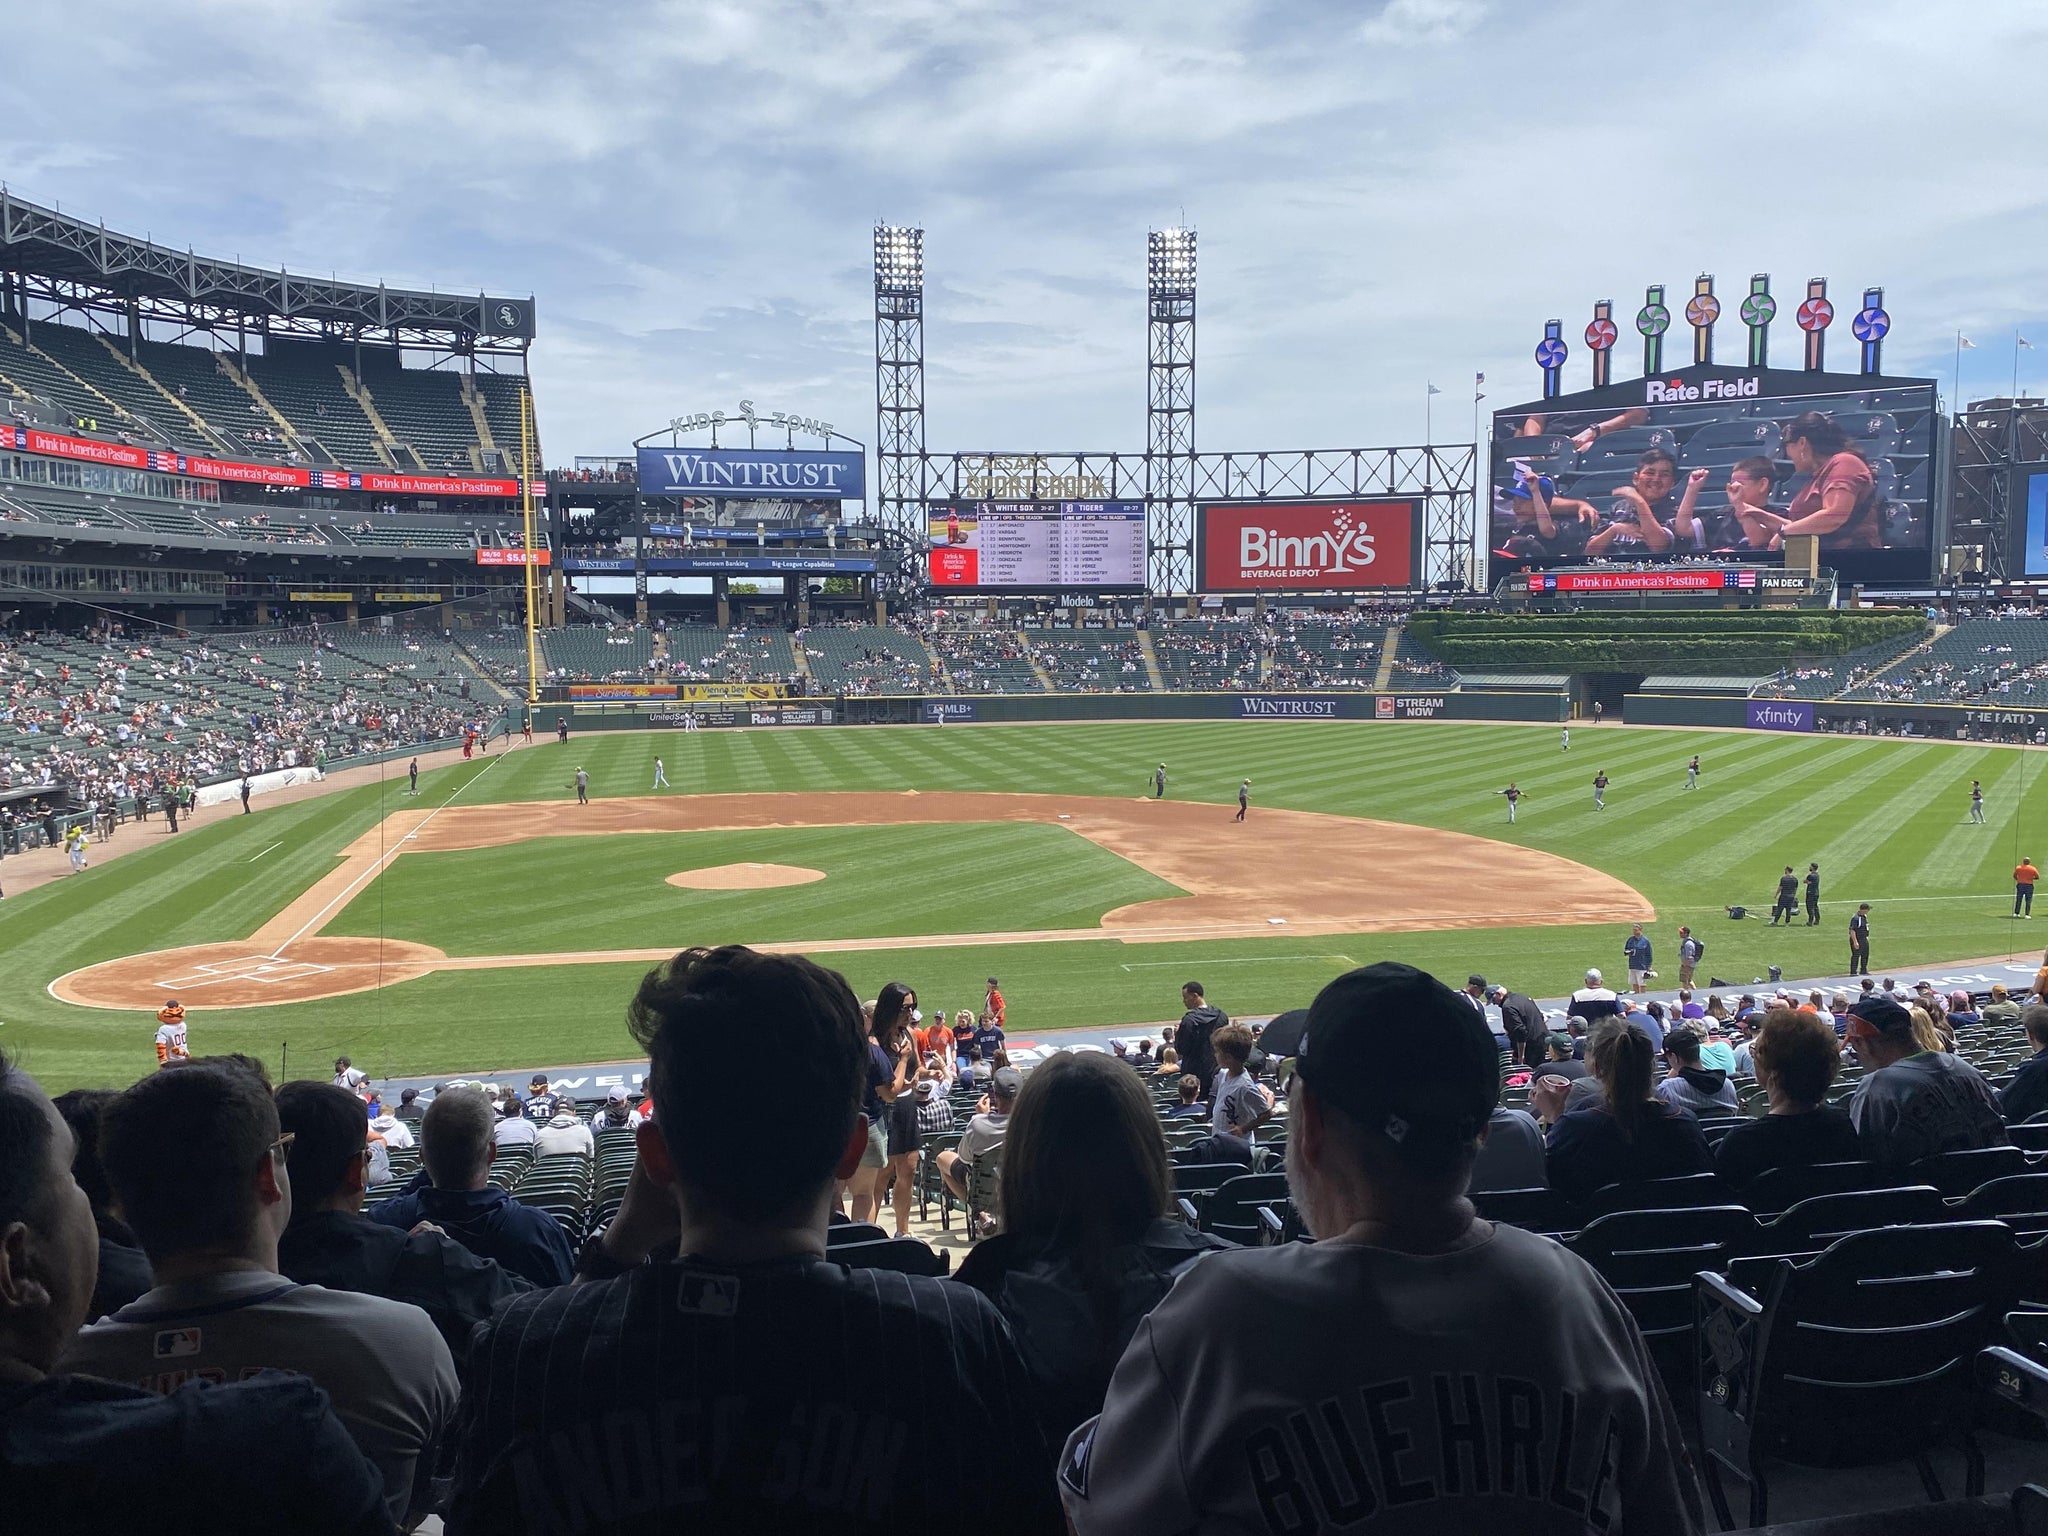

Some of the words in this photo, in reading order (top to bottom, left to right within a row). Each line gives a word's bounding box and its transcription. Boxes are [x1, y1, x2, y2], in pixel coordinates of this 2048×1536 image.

[1646, 380, 1699, 403] Rate
[1703, 377, 1759, 399] Field
[669, 410, 727, 435] KIDS
[771, 411, 834, 440] ZONE
[36, 436, 59, 451] Drink
[60, 438, 68, 452] in
[68, 441, 107, 459] America's
[107, 448, 137, 464] Pastime
[966, 455, 1049, 471] CAESARS
[194, 462, 211, 473] Drink
[212, 463, 221, 475] in
[222, 465, 262, 480] America's
[262, 470, 296, 483] Pastime
[663, 454, 842, 487] WINTRUST
[372, 477, 400, 489] Drink
[402, 478, 411, 489] in
[413, 479, 460, 492] America's
[462, 481, 503, 493] Pastime
[966, 475, 1106, 498] SPORTSBOOK
[1240, 521, 1376, 573] Binny's
[578, 560, 621, 569] WINTRUST
[692, 560, 724, 568] Hometown
[725, 560, 749, 569] Banking
[771, 560, 803, 569] Big-League
[803, 561, 836, 569] Capabilities
[1240, 569, 1288, 578] BEVERAGE
[1289, 569, 1320, 577] DEPOT
[1572, 577, 1600, 588] Drink
[1602, 576, 1612, 588] in
[1614, 575, 1664, 588] America's
[1666, 575, 1709, 587] Pastime
[1762, 578, 1781, 588] FAN
[1782, 578, 1804, 588] DECK
[1061, 595, 1094, 607] Modelo
[595, 687, 632, 698] Surfside
[701, 686, 728, 694] Vienna
[731, 685, 749, 694] Beef
[945, 704, 973, 714] MLB+
[1242, 697, 1336, 714] WINTRUST
[1396, 699, 1444, 708] STREAM
[751, 713, 776, 725] Rate
[1406, 708, 1434, 717] NOW
[1755, 707, 1803, 727] xfinity
[174, 1032, 187, 1046] 00
[527, 1104, 550, 1118] 30
[1998, 1369, 2022, 1392] 34
